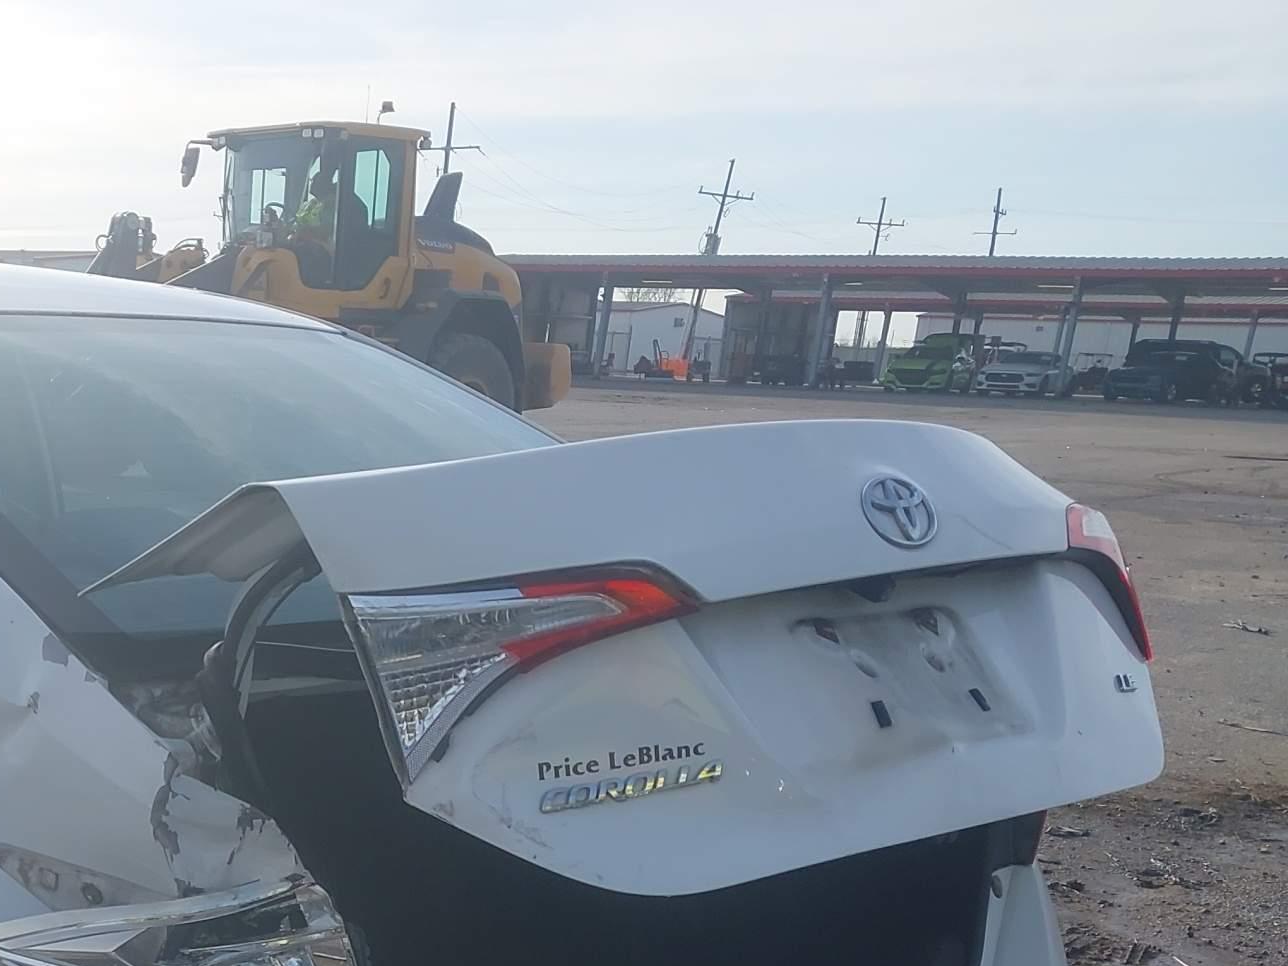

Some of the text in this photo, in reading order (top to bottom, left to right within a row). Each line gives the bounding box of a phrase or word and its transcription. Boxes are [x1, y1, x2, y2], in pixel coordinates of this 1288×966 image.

[538, 741, 706, 781] Price LeBlanc
[539, 758, 724, 814] COROLLA
